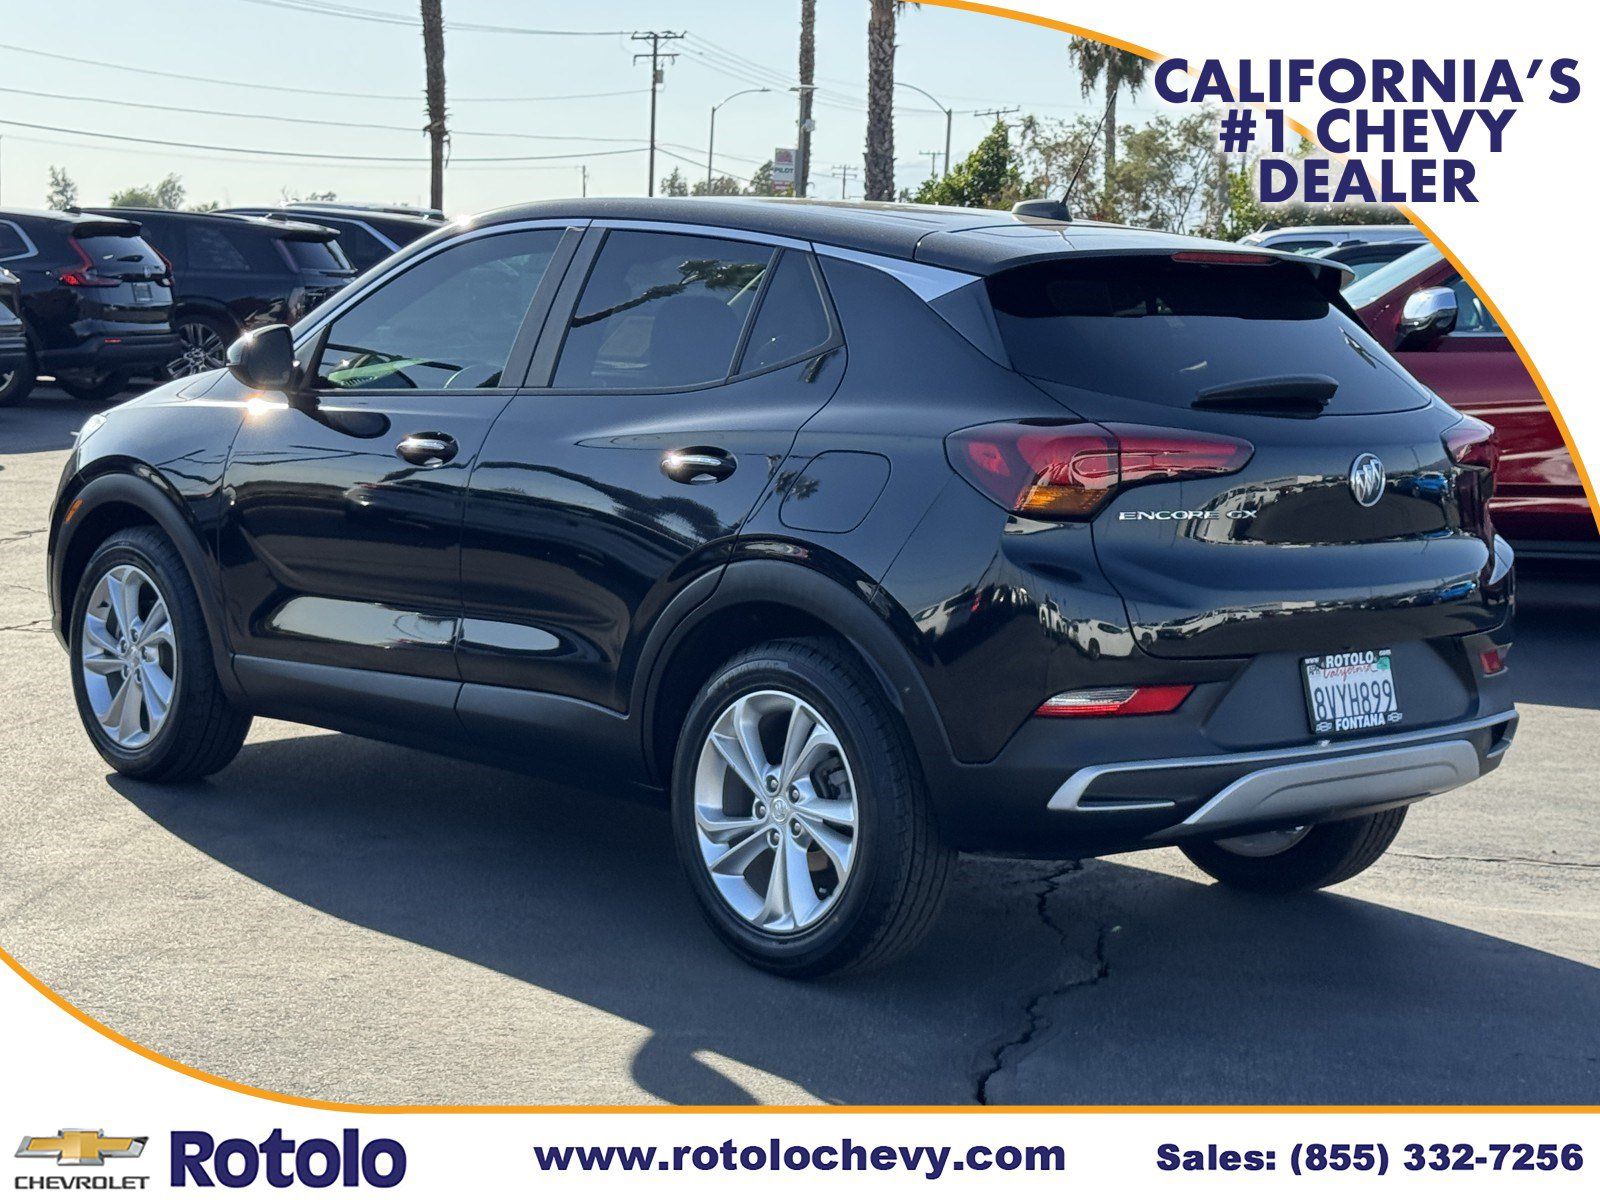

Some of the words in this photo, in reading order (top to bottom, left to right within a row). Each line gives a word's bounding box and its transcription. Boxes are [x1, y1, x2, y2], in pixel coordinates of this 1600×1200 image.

[1118, 511, 1220, 520] ENCORE
[1226, 510, 1257, 519] GX
[1325, 651, 1374, 668] ROTOLO
[1314, 679, 1392, 720] 8VYH899
[1335, 713, 1386, 731] FONTANA
